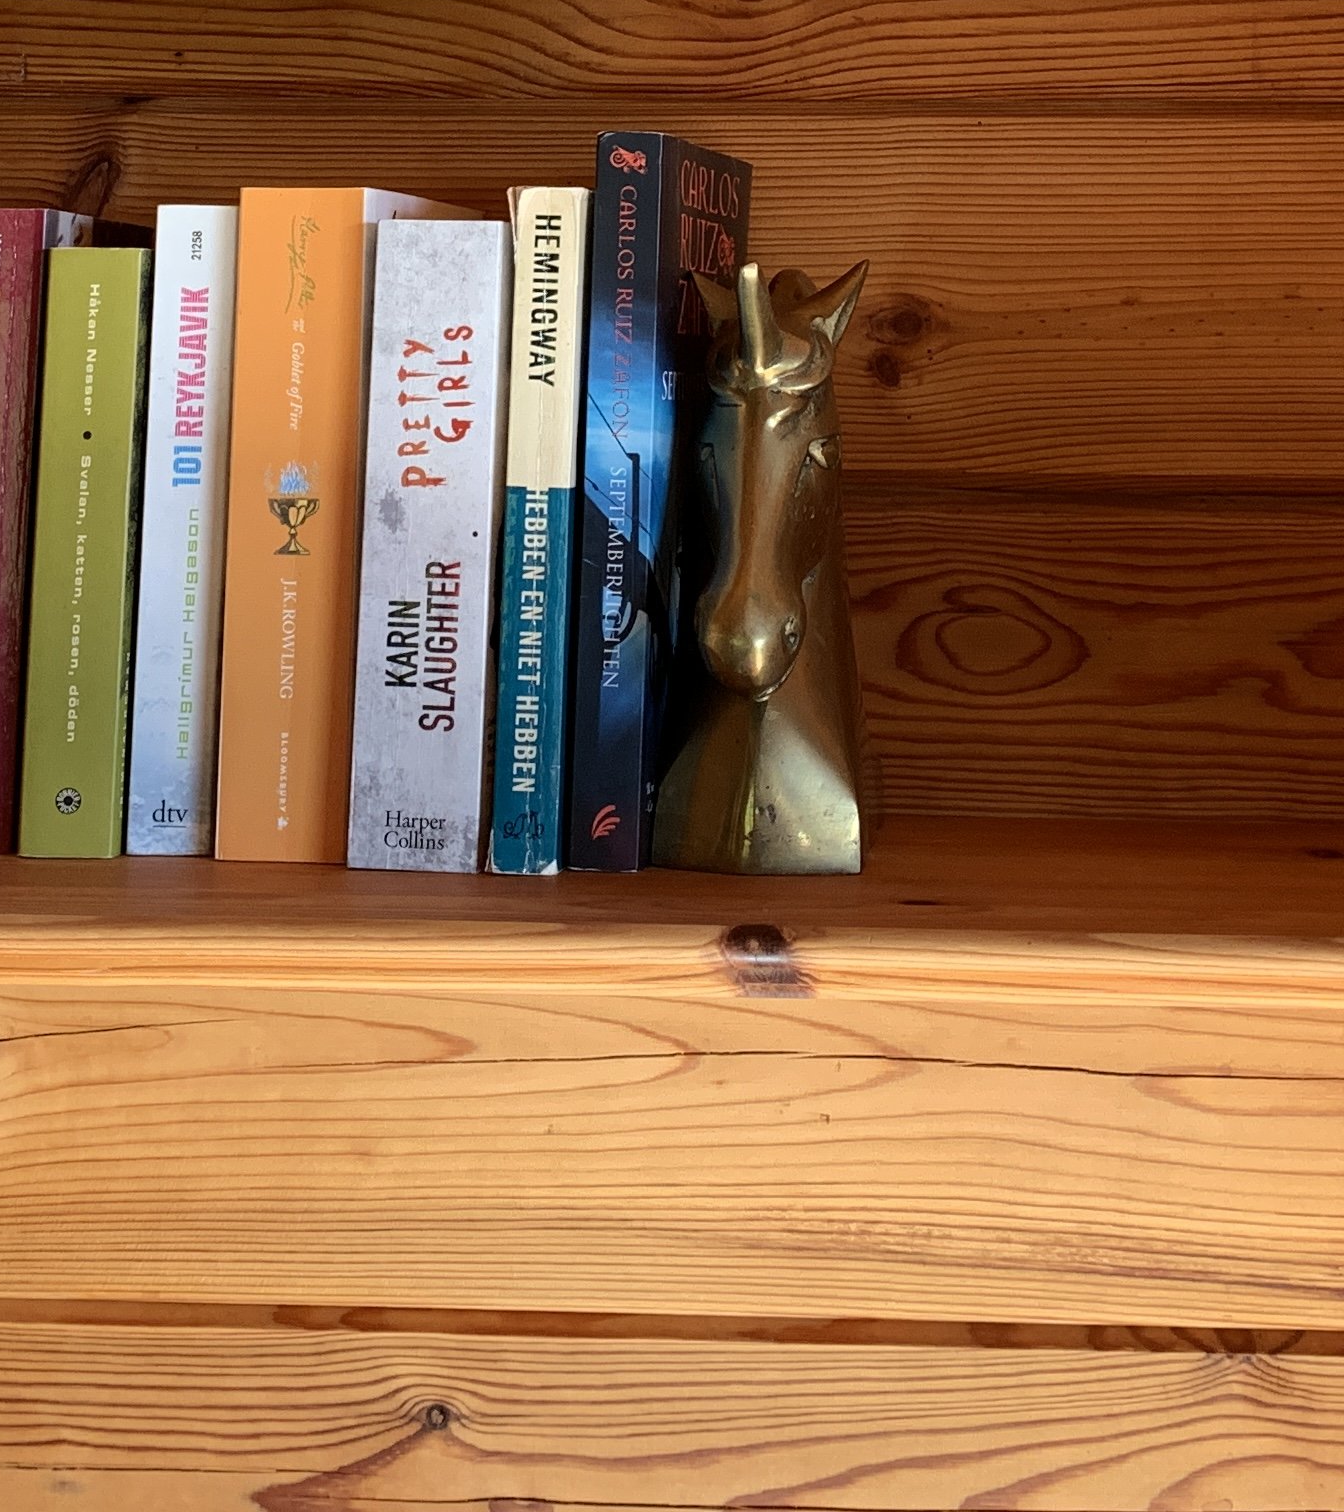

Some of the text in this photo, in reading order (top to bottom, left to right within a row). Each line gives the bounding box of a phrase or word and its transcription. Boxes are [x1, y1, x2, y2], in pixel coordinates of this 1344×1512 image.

[617, 185, 638, 280] CARLOS
[680, 159, 741, 219] CARLOS
[679, 213, 719, 275] RUIZ
[528, 214, 562, 388] HEMINGWAY
[614, 287, 635, 345] RUIZ
[172, 230, 209, 487] 101 REYKJAVIK 21258
[286, 342, 305, 431] Goblet of Fire
[433, 324, 474, 443] GIRLS
[397, 338, 447, 489] PRETTY
[66, 283, 101, 742] Håkan Nesser Svalan, katten, rosen, döden
[602, 467, 626, 690] SEPTEMBERLICHTEN
[176, 508, 200, 759] Hallgrímur Helgason
[385, 600, 421, 687] KARIN
[418, 559, 462, 732] SLAUGHTER
[511, 487, 550, 794] HEBBEN EN NIET HEBBEN
[152, 799, 189, 823] dtv
[278, 732, 289, 812] BLOOMSBURY
[384, 809, 447, 830] Harper
[383, 829, 446, 850] Collins
